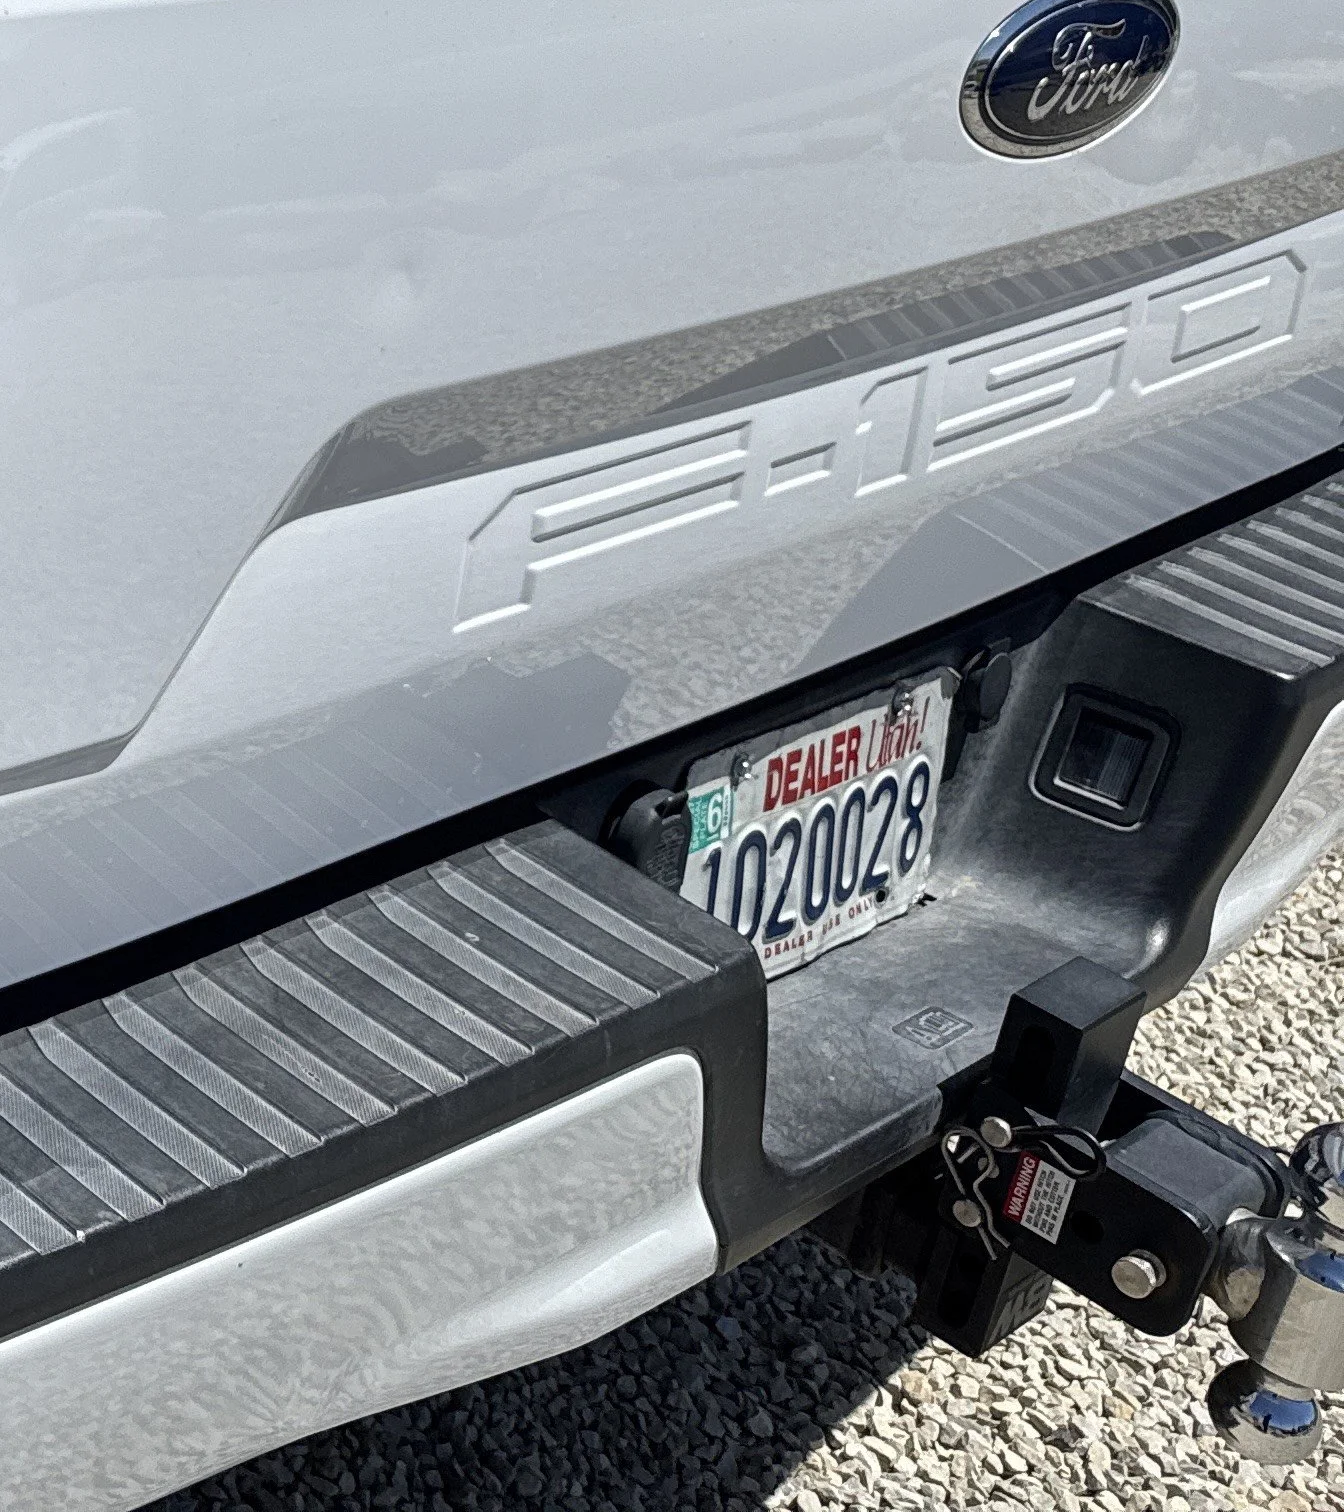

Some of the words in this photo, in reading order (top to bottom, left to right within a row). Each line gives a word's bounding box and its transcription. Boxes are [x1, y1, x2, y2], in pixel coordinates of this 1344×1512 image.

[1027, 18, 1150, 123] Ford
[452, 249, 1307, 633] F-150
[762, 724, 862, 813] DEALER
[702, 760, 931, 942] 1020028
[763, 930, 813, 960] DEALER
[848, 896, 874, 919] ONLY
[1007, 1156, 1037, 1217] WARNING
